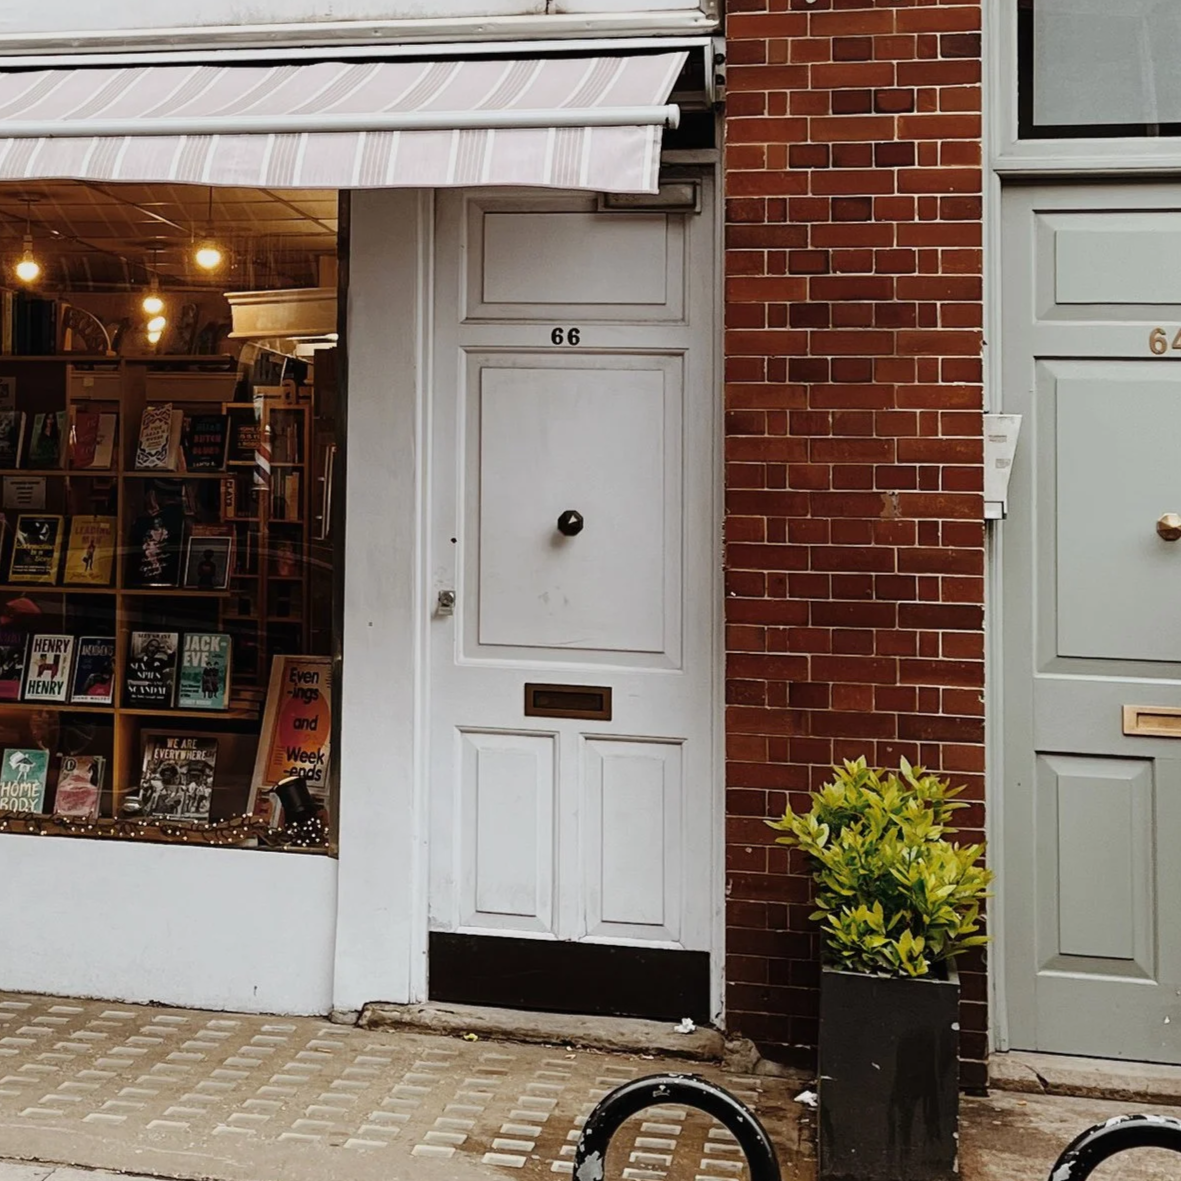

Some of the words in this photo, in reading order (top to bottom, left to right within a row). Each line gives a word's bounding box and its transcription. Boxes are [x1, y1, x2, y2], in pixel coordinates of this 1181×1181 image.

[550, 327, 581, 346] 66
[33, 638, 71, 654] HENRY
[184, 635, 221, 652] JACK
[183, 651, 210, 668] EVE
[289, 667, 319, 685] Even
[27, 679, 65, 696] HENRY
[287, 682, 320, 704] -ings
[292, 714, 319, 732] and
[166, 737, 180, 749] WE
[180, 737, 198, 750] ARE
[154, 748, 208, 761] EVERYWHERE
[286, 745, 325, 766] Week
[0, 780, 40, 798] HOME
[0, 797, 39, 812] BODY
